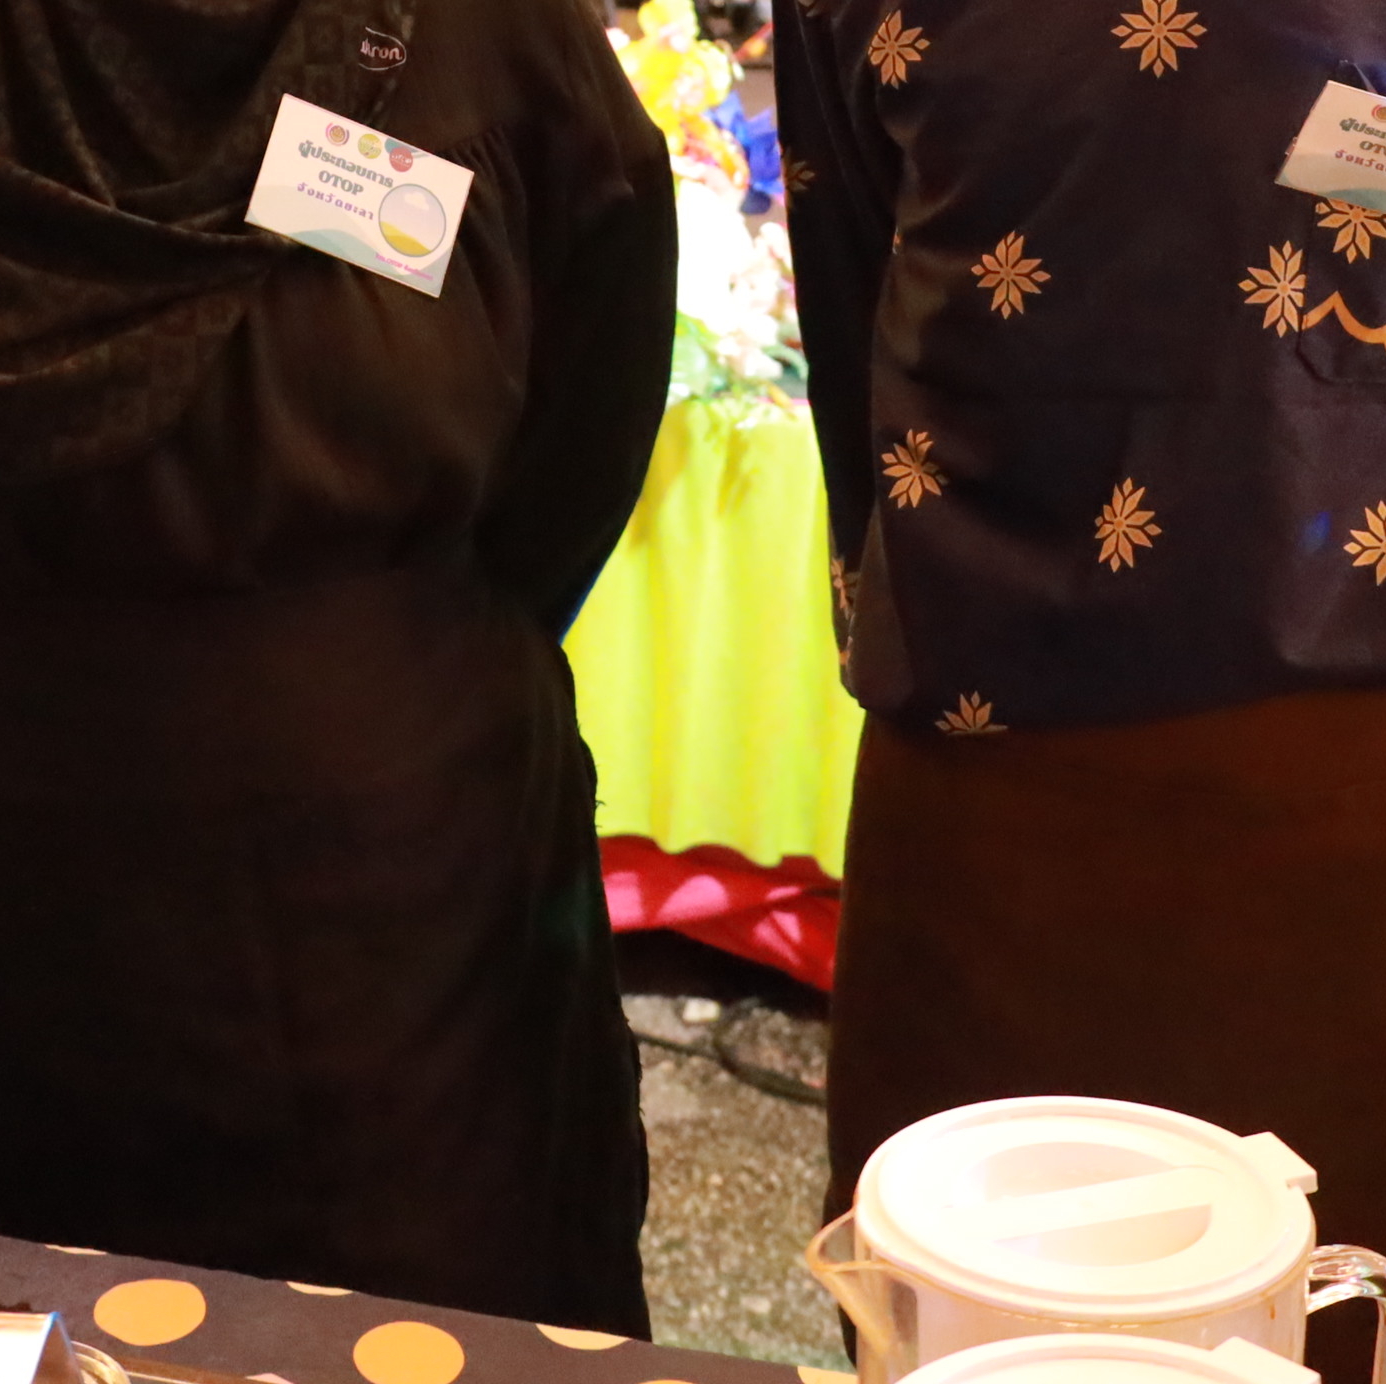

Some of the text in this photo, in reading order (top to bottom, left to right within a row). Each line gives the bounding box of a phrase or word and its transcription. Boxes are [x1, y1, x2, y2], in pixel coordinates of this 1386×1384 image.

[298, 139, 394, 189] ผู้ประกอบการ
[318, 169, 365, 196] OTOP
[296, 182, 374, 221] จังหวัดยะลา
